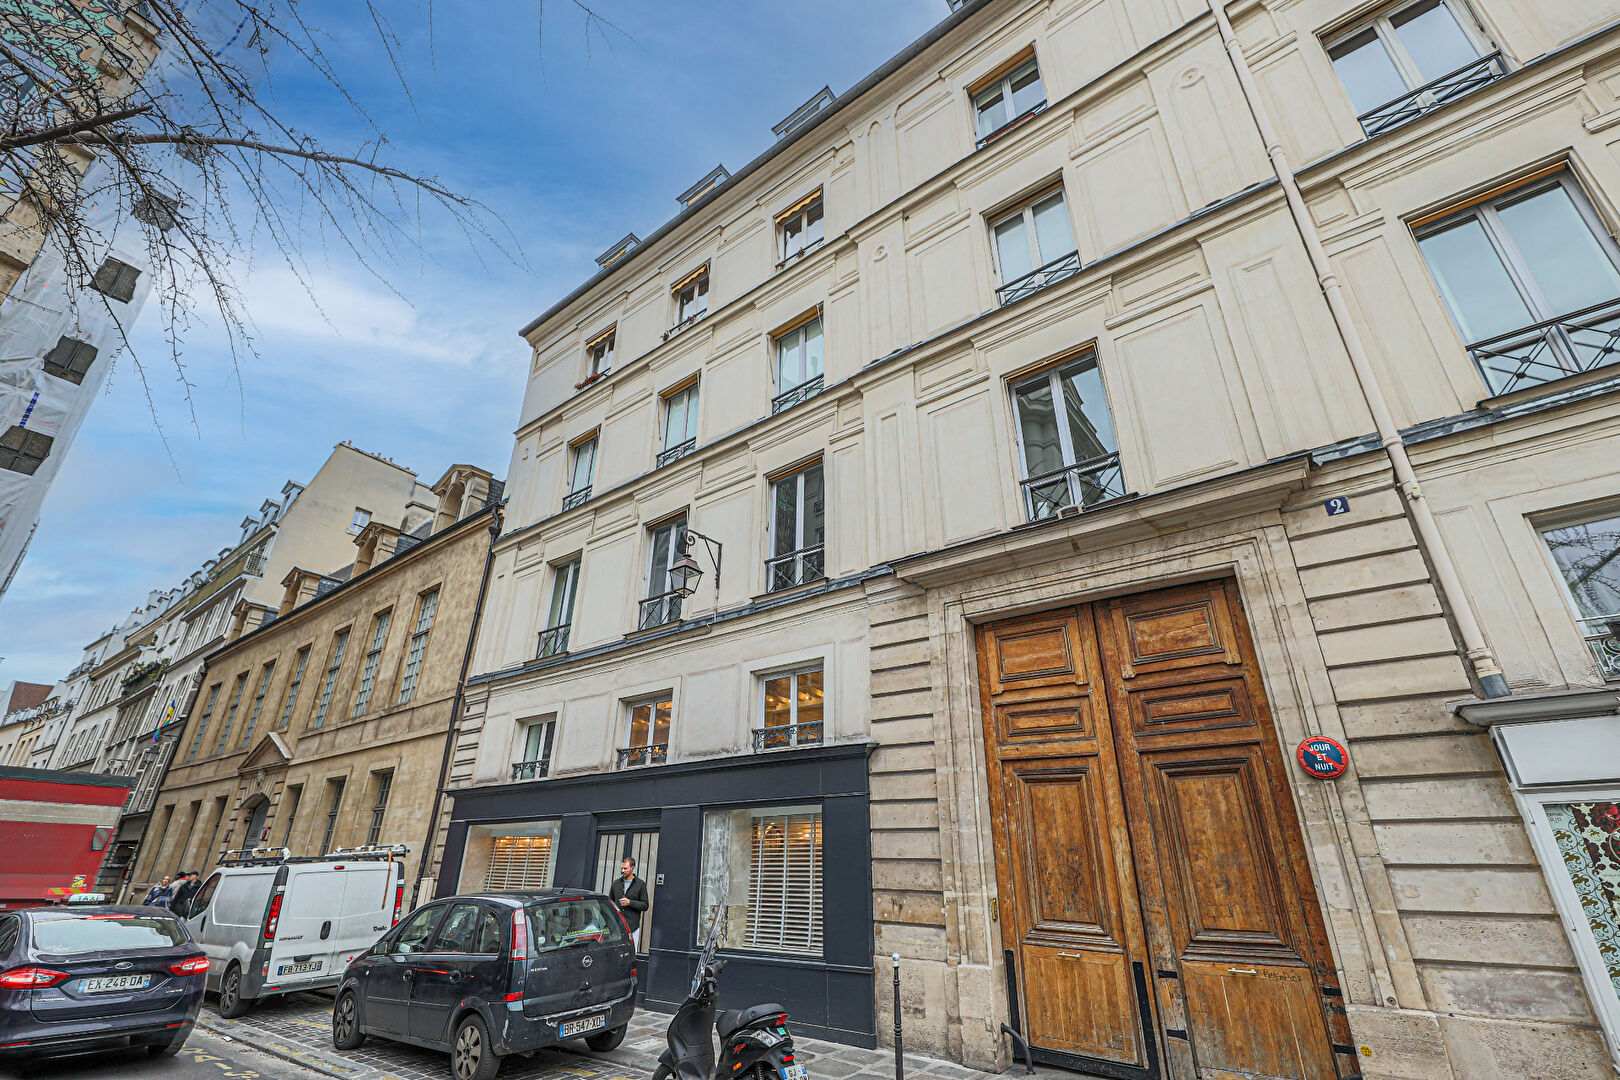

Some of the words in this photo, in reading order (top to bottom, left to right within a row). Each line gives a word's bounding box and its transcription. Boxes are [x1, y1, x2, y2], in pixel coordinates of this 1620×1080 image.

[1330, 499, 1344, 514] 2
[1310, 743, 1330, 751] JOUR
[1316, 753, 1327, 761] ET
[1314, 762, 1334, 771] NUIT
